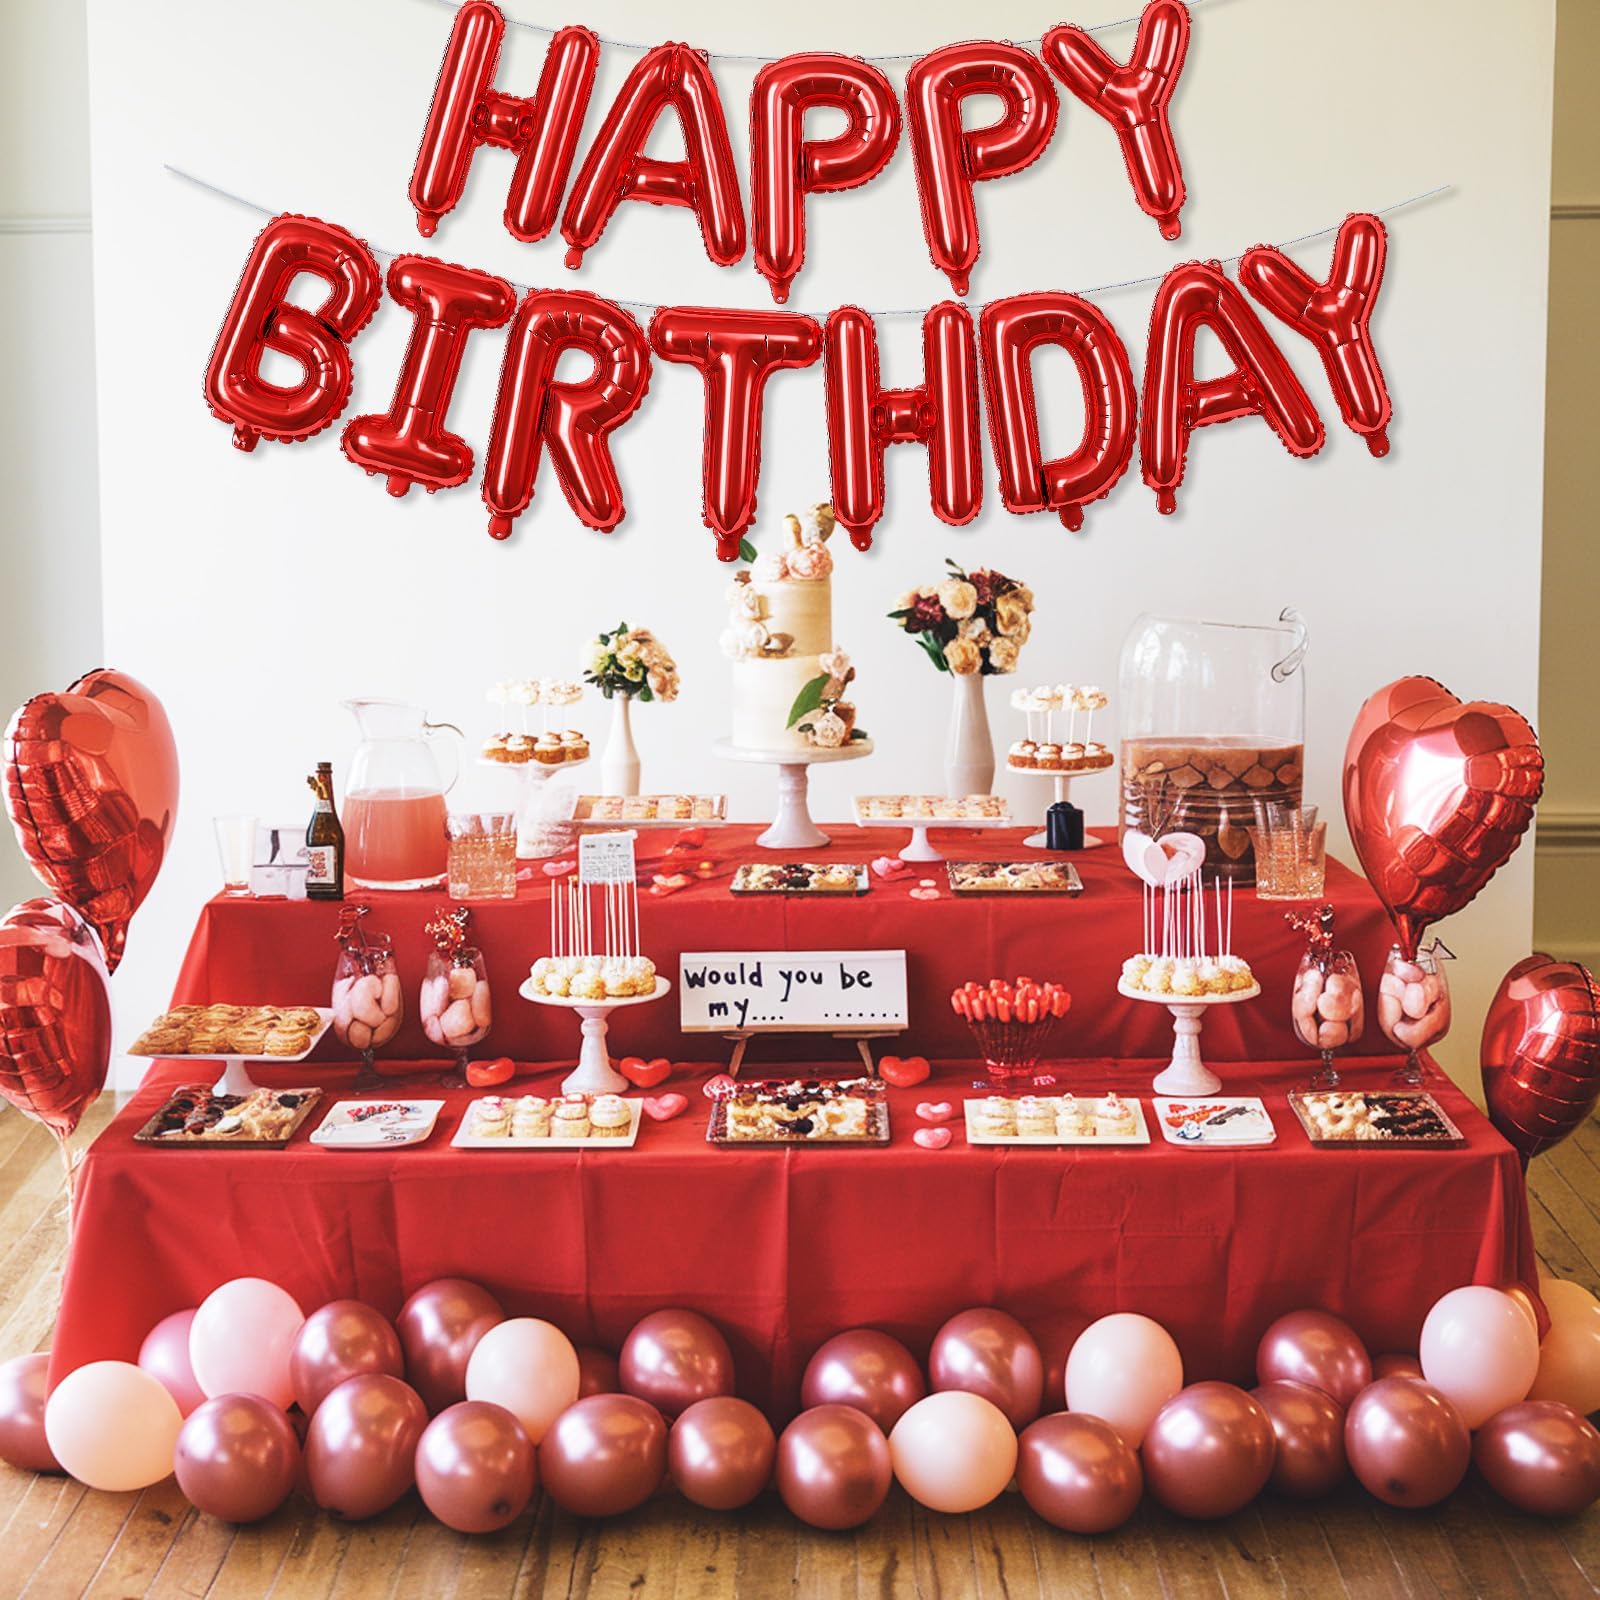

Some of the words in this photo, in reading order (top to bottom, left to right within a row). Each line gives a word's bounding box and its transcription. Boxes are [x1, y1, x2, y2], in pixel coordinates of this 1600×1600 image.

[409, 0, 1191, 304] HAPPY
[204, 212, 1392, 562] BIRTHDAY
[684, 962, 762, 988] Would
[779, 970, 823, 1002] you
[840, 963, 873, 989] be
